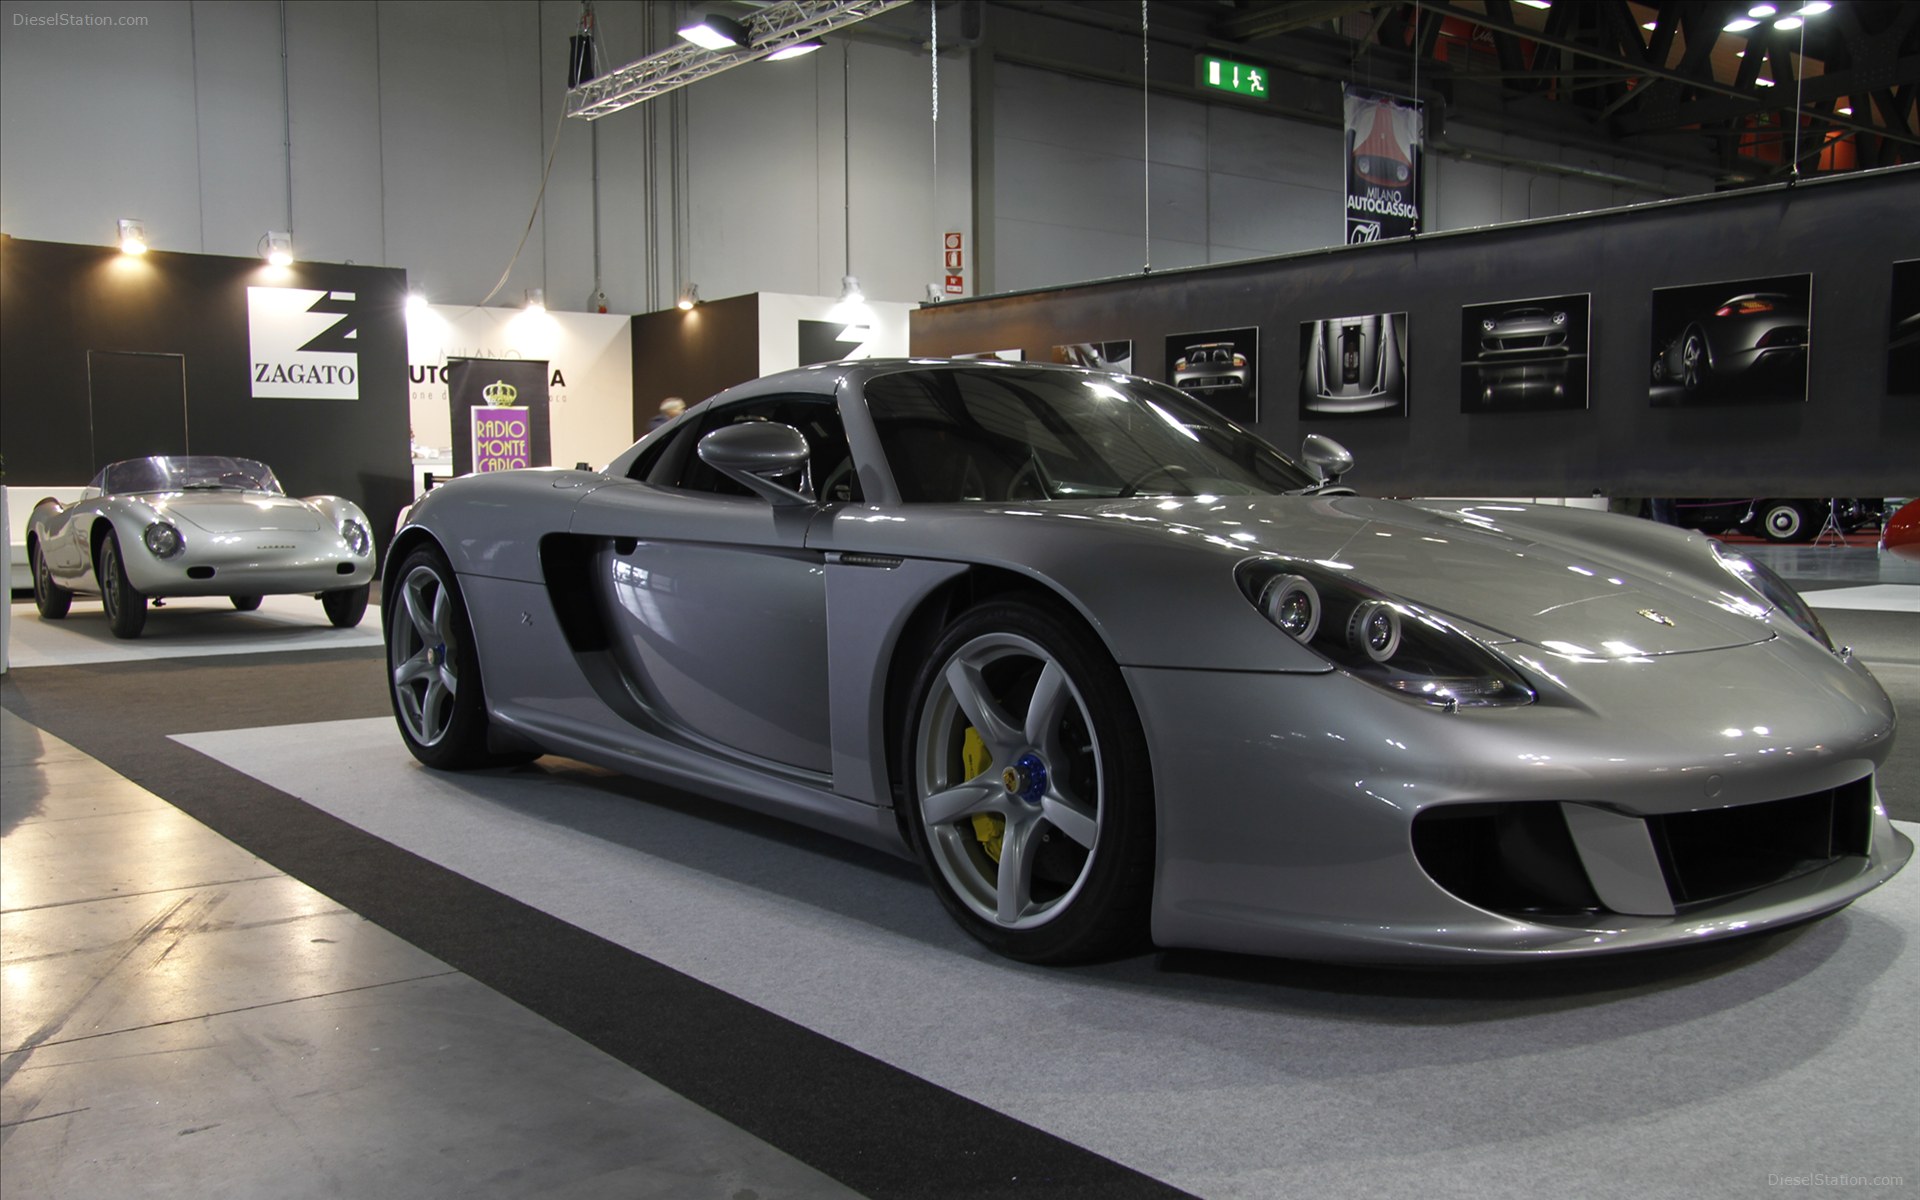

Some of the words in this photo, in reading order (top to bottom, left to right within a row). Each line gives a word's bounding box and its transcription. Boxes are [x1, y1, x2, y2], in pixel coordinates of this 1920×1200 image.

[1367, 187, 1401, 203] MILANO
[1347, 195, 1419, 219] AUTOCLASSICA
[255, 363, 355, 385] ZAGATO
[477, 420, 526, 438] RADIO
[477, 440, 526, 457] MONTE
